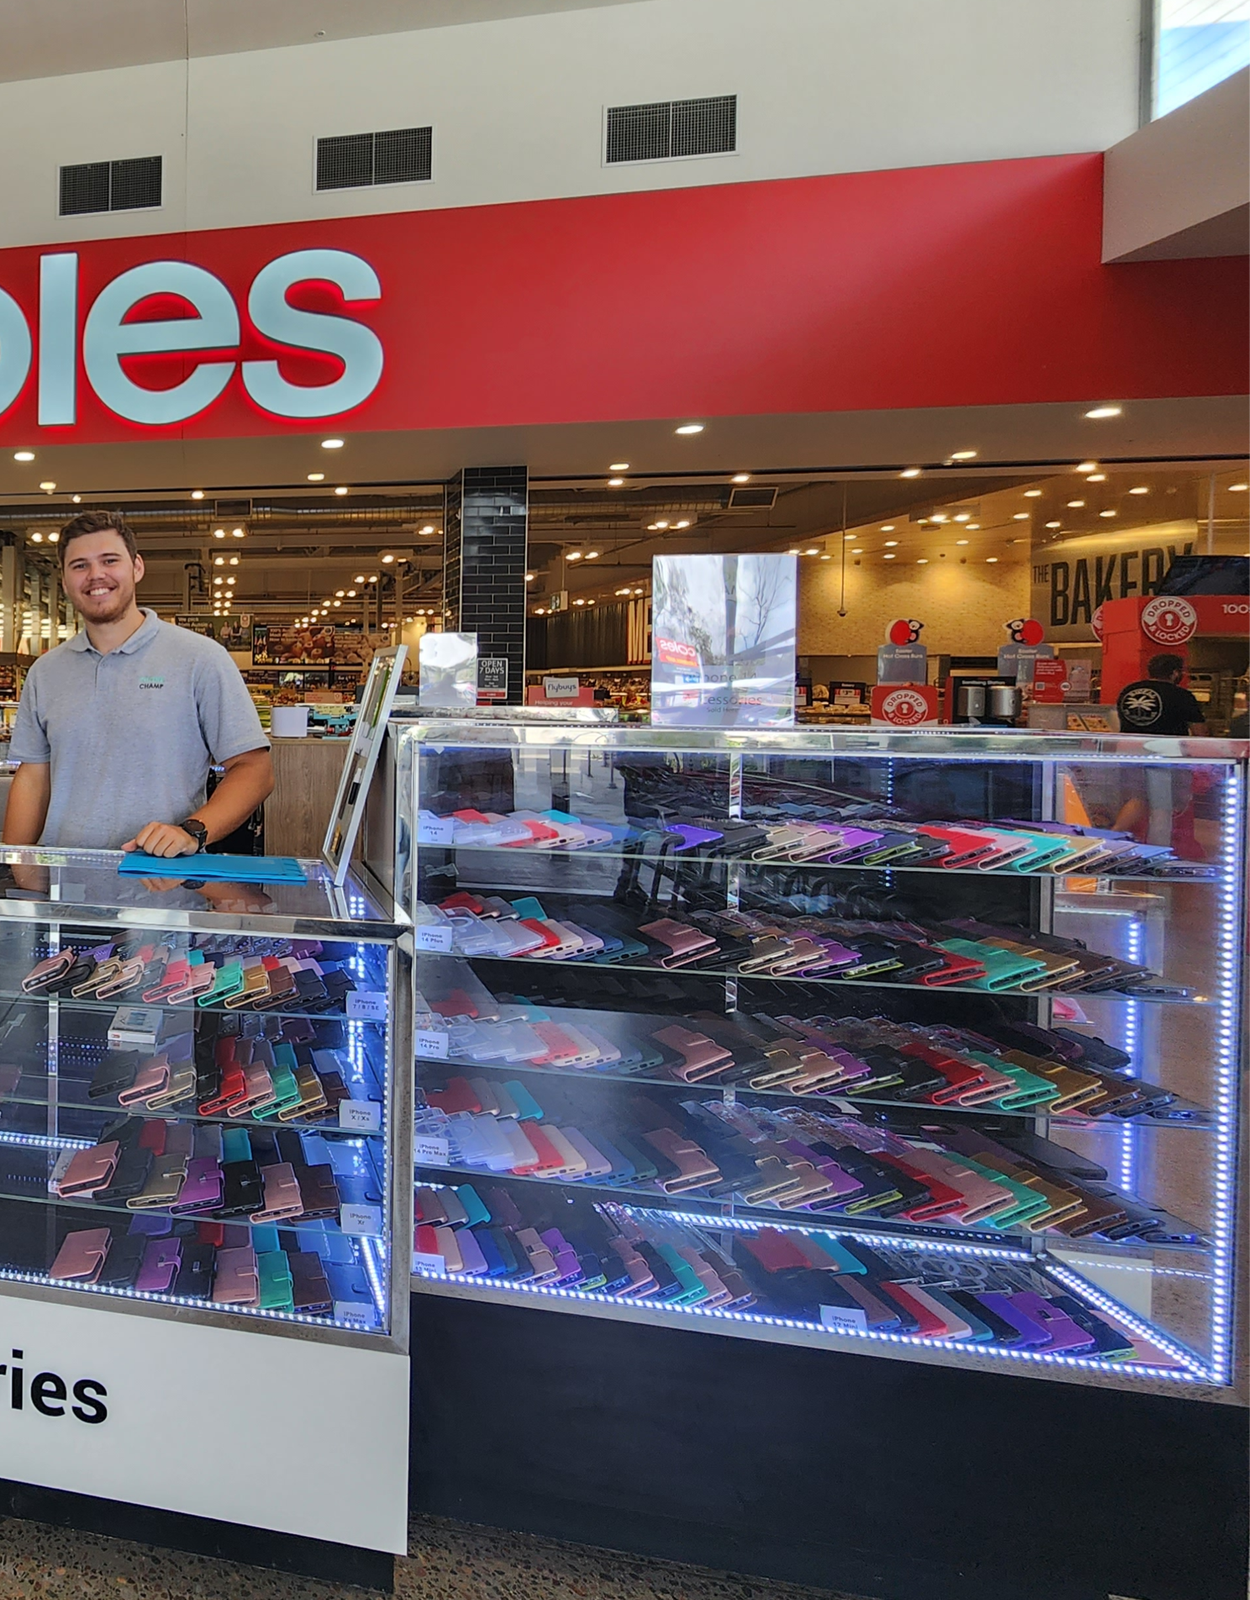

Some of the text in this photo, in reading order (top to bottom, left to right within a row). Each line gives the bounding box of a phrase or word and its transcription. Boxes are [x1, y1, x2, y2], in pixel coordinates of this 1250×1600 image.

[1033, 564, 1050, 584] THE
[1147, 600, 1192, 618] DROPPED
[1155, 625, 1191, 641] LOCKED
[481, 660, 503, 668] OPEN
[479, 667, 505, 675] 7 DAYS
[547, 682, 577, 693] flybuys
[886, 692, 924, 708] DROPPED
[893, 713, 922, 725] LOCKED
[343, 1311, 366, 1319] iPhone
[831, 1315, 856, 1323] iPhone
